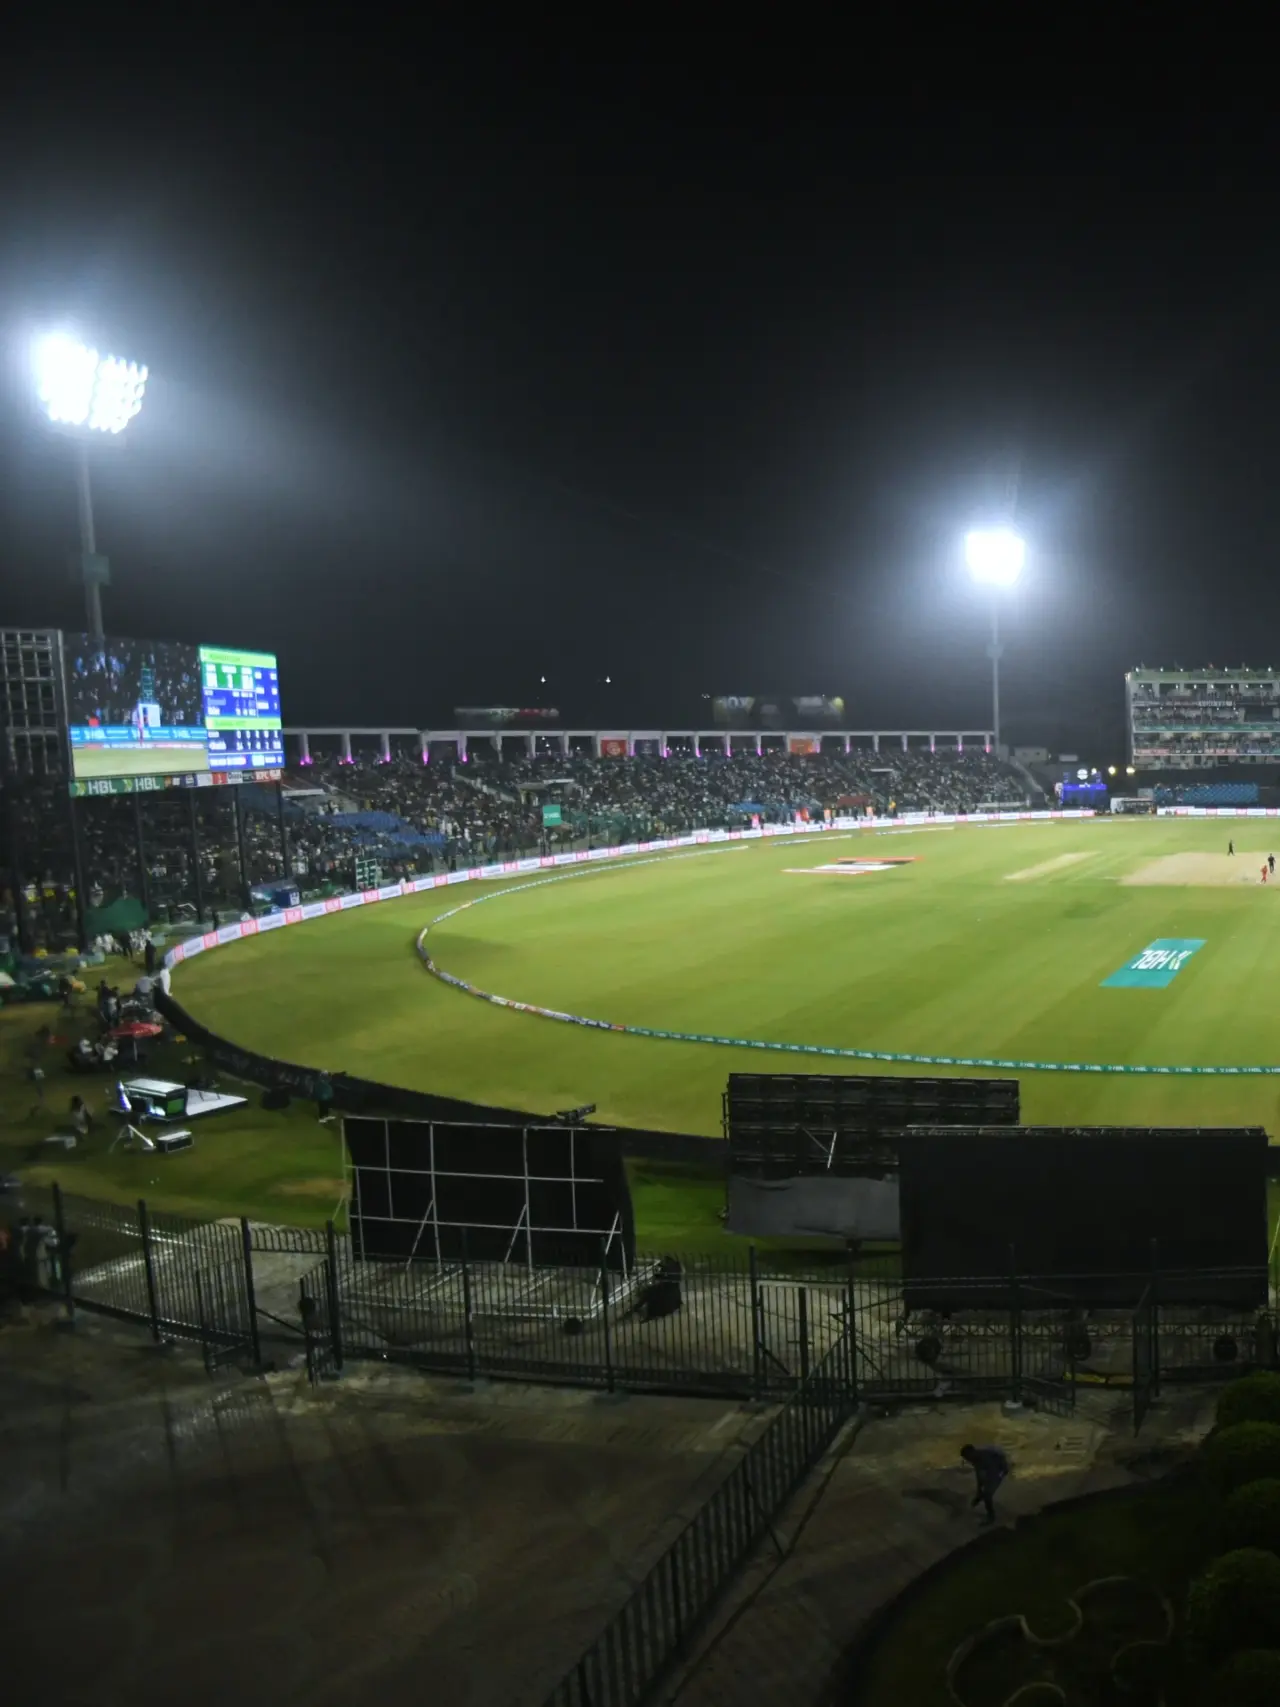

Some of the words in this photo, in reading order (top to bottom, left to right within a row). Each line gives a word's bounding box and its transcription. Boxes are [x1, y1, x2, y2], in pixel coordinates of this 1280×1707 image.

[88, 780, 117, 794] HBL
[135, 777, 160, 791] HBL
[1131, 950, 1179, 970] HBL
